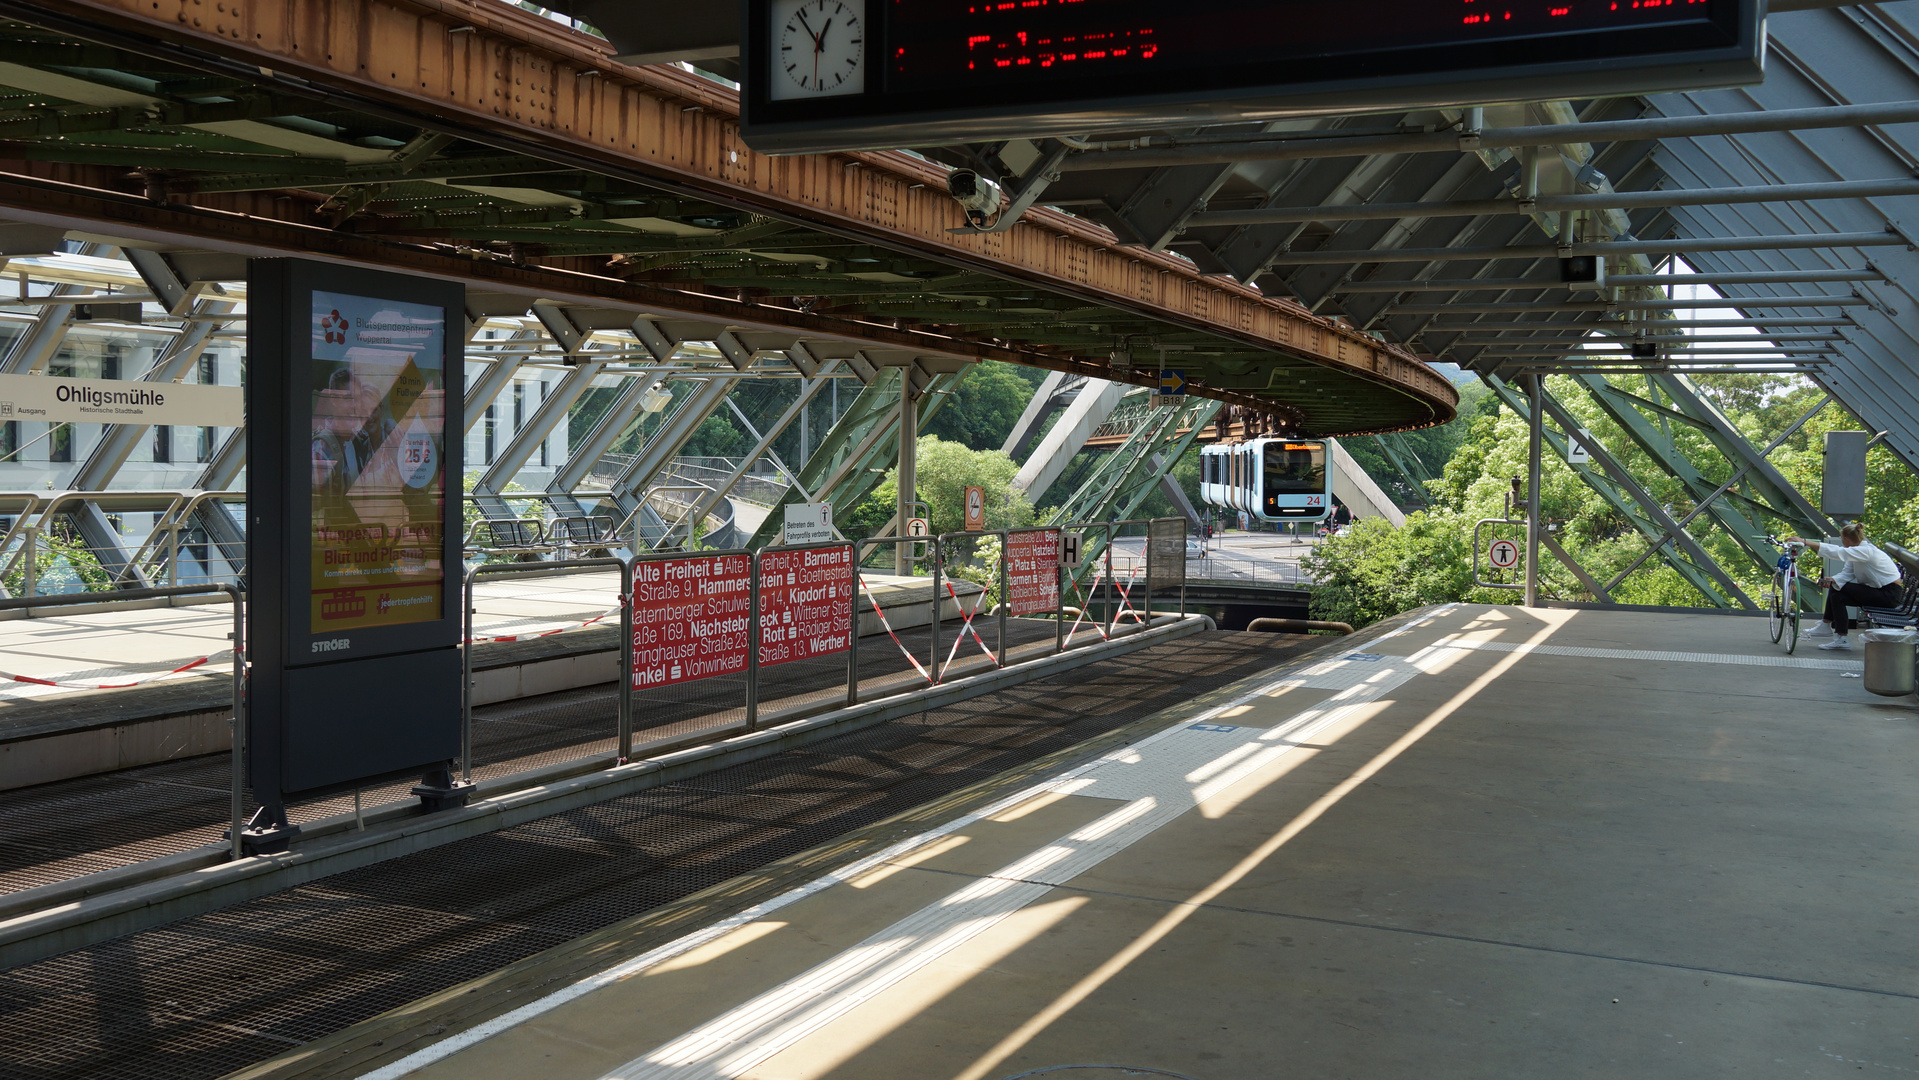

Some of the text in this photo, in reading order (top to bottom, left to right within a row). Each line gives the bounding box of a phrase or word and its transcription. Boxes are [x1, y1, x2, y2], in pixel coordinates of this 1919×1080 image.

[355, 318, 433, 336] Blutspendezentrum
[355, 333, 392, 344] Wuppertal
[400, 376, 421, 386] 10 min
[56, 385, 165, 407] Ohligsmühle
[1163, 396, 1180, 405] B18
[17, 407, 46, 415] Ausgang
[80, 406, 113, 414] Historische
[405, 449, 430, 464] 25 €
[1306, 496, 1321, 506] 24
[316, 523, 435, 544] Wuppertal spendet
[787, 521, 806, 529] Betreten
[786, 530, 830, 540] Fahrprofils verboten
[1035, 531, 1044, 544] 20,
[324, 549, 351, 565] Blut
[354, 548, 377, 563] und
[1032, 544, 1055, 557] Hatzfeld
[1063, 537, 1077, 563] H
[634, 564, 660, 582] Alte
[664, 561, 710, 579] Freiheit
[724, 557, 744, 574] Alte
[760, 552, 790, 571] reiheit
[793, 552, 802, 569] 5,
[804, 551, 841, 567] Barmen
[1014, 559, 1030, 571] Platz
[324, 569, 343, 577] Komm
[344, 568, 362, 576] direkt
[759, 571, 783, 588] tein
[1038, 571, 1056, 583] Berliner
[640, 581, 679, 602] Straße
[684, 580, 694, 599] 9,
[771, 589, 786, 607] 14,
[789, 584, 827, 606] Kipdorf
[632, 595, 750, 624] aternberger Schulwe
[1010, 598, 1047, 614] Wichlinghauser
[759, 609, 779, 627] eck
[793, 604, 831, 622] Wittener
[661, 622, 686, 641] 169,
[690, 615, 750, 638] Nächstebr
[763, 625, 785, 643] Rott
[798, 620, 832, 640] Rödiger
[311, 638, 350, 653] STRÖER
[632, 643, 697, 667] tringhauser
[700, 634, 734, 655] Straße
[758, 634, 846, 663] Straße 13, Werther
[632, 663, 666, 686] inkel
[685, 652, 745, 677] Vohwinkeler
